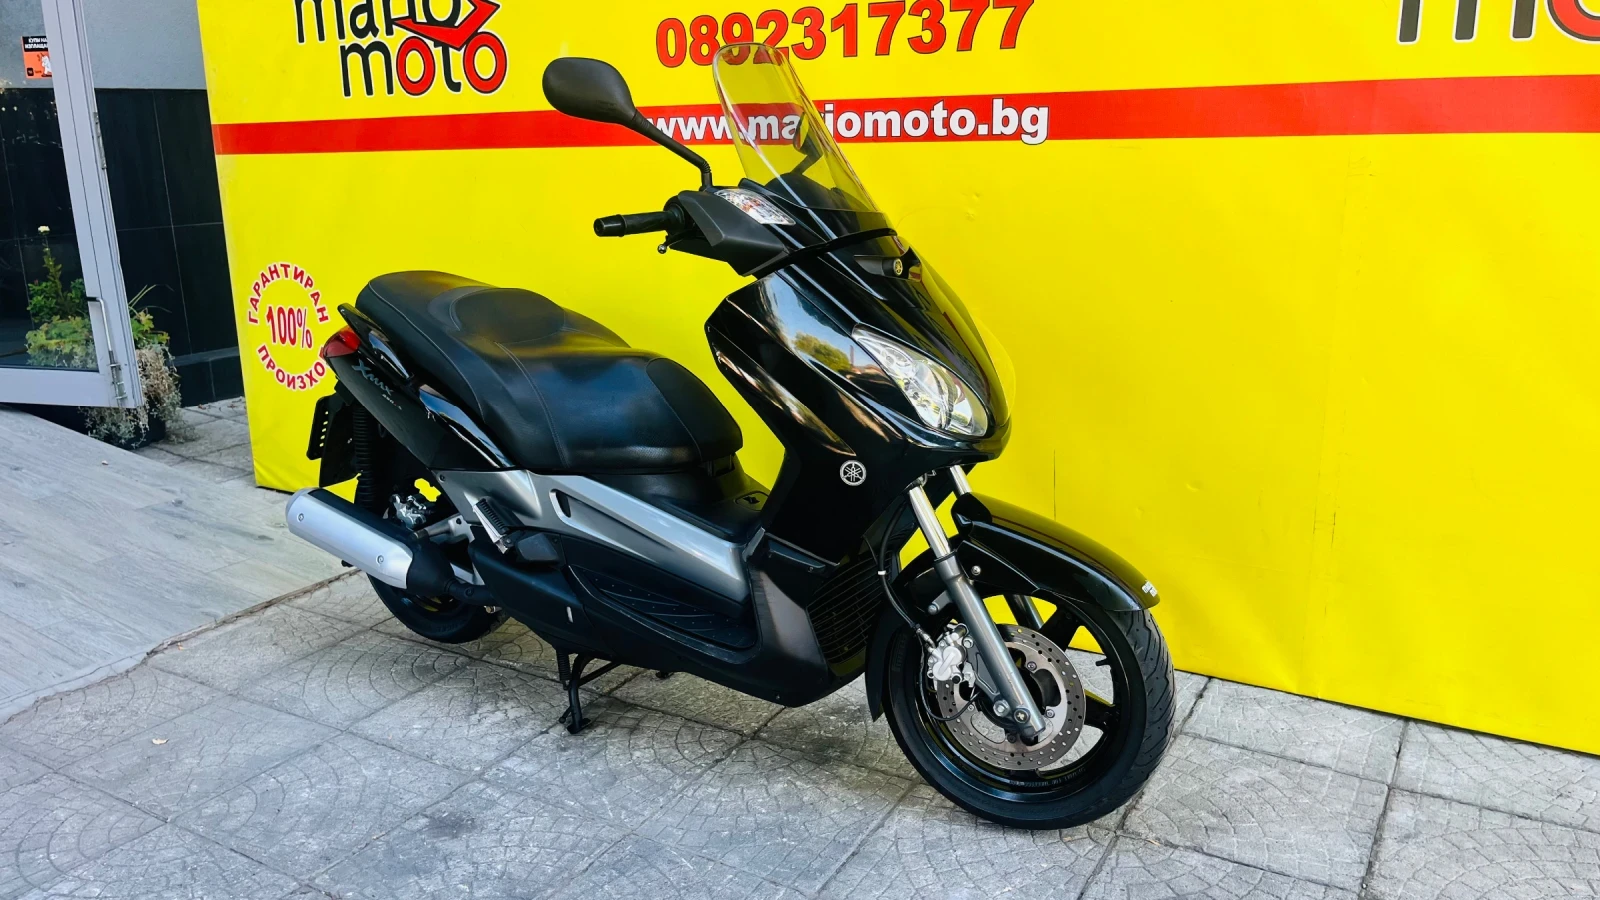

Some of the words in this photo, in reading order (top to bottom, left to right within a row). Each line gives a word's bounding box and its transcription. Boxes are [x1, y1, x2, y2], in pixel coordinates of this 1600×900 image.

[656, 0, 1033, 67] 0892317377
[339, 31, 507, 97] moto
[646, 98, 1050, 145] www.maiomoto.bg
[248, 263, 329, 324] ГАРАНТИРАН
[266, 306, 312, 349] 100%
[257, 344, 325, 390] ПРОИЗХО
